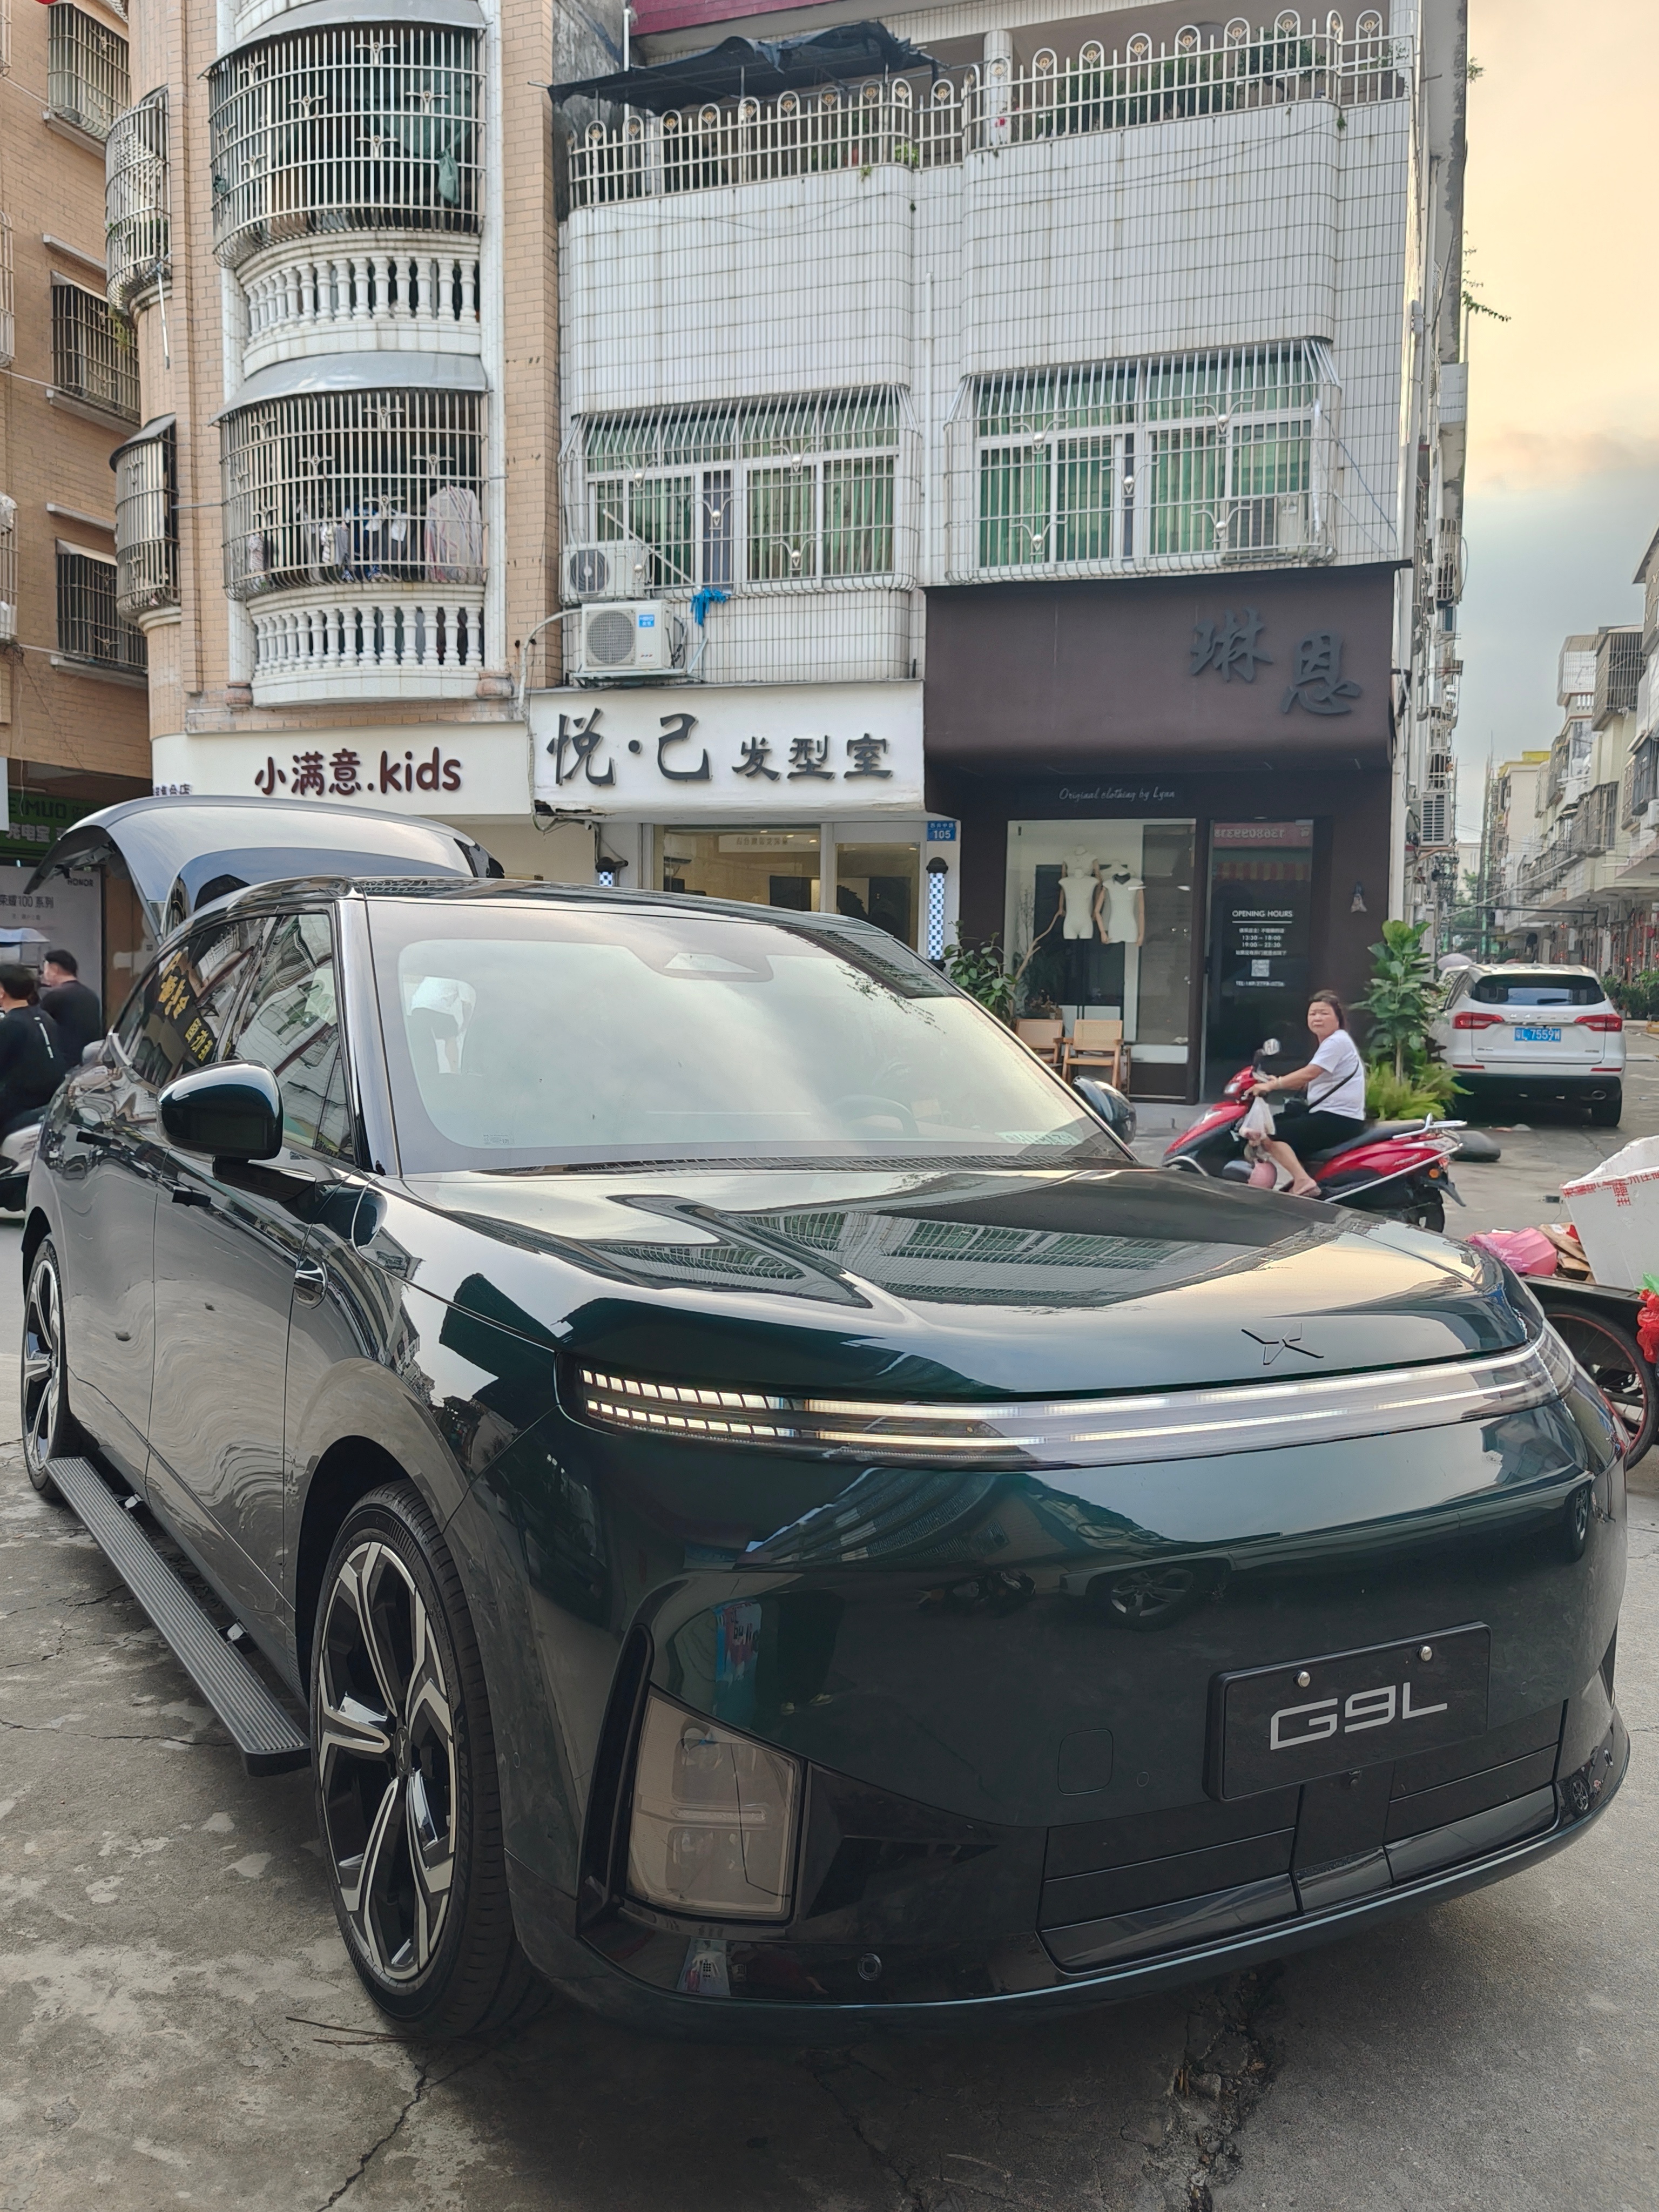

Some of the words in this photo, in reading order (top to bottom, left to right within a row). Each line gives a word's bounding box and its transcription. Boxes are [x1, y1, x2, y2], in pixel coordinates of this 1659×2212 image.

[732, 733, 894, 782] 发型室
[1058, 787, 1100, 802] Original
[1101, 787, 1136, 802] clothing
[1139, 788, 1150, 801] by
[1152, 786, 1176, 801] Lynn
[934, 830, 951, 839] 105
[68, 878, 94, 887] HONOR
[1270, 1682, 1447, 1750] G9L
